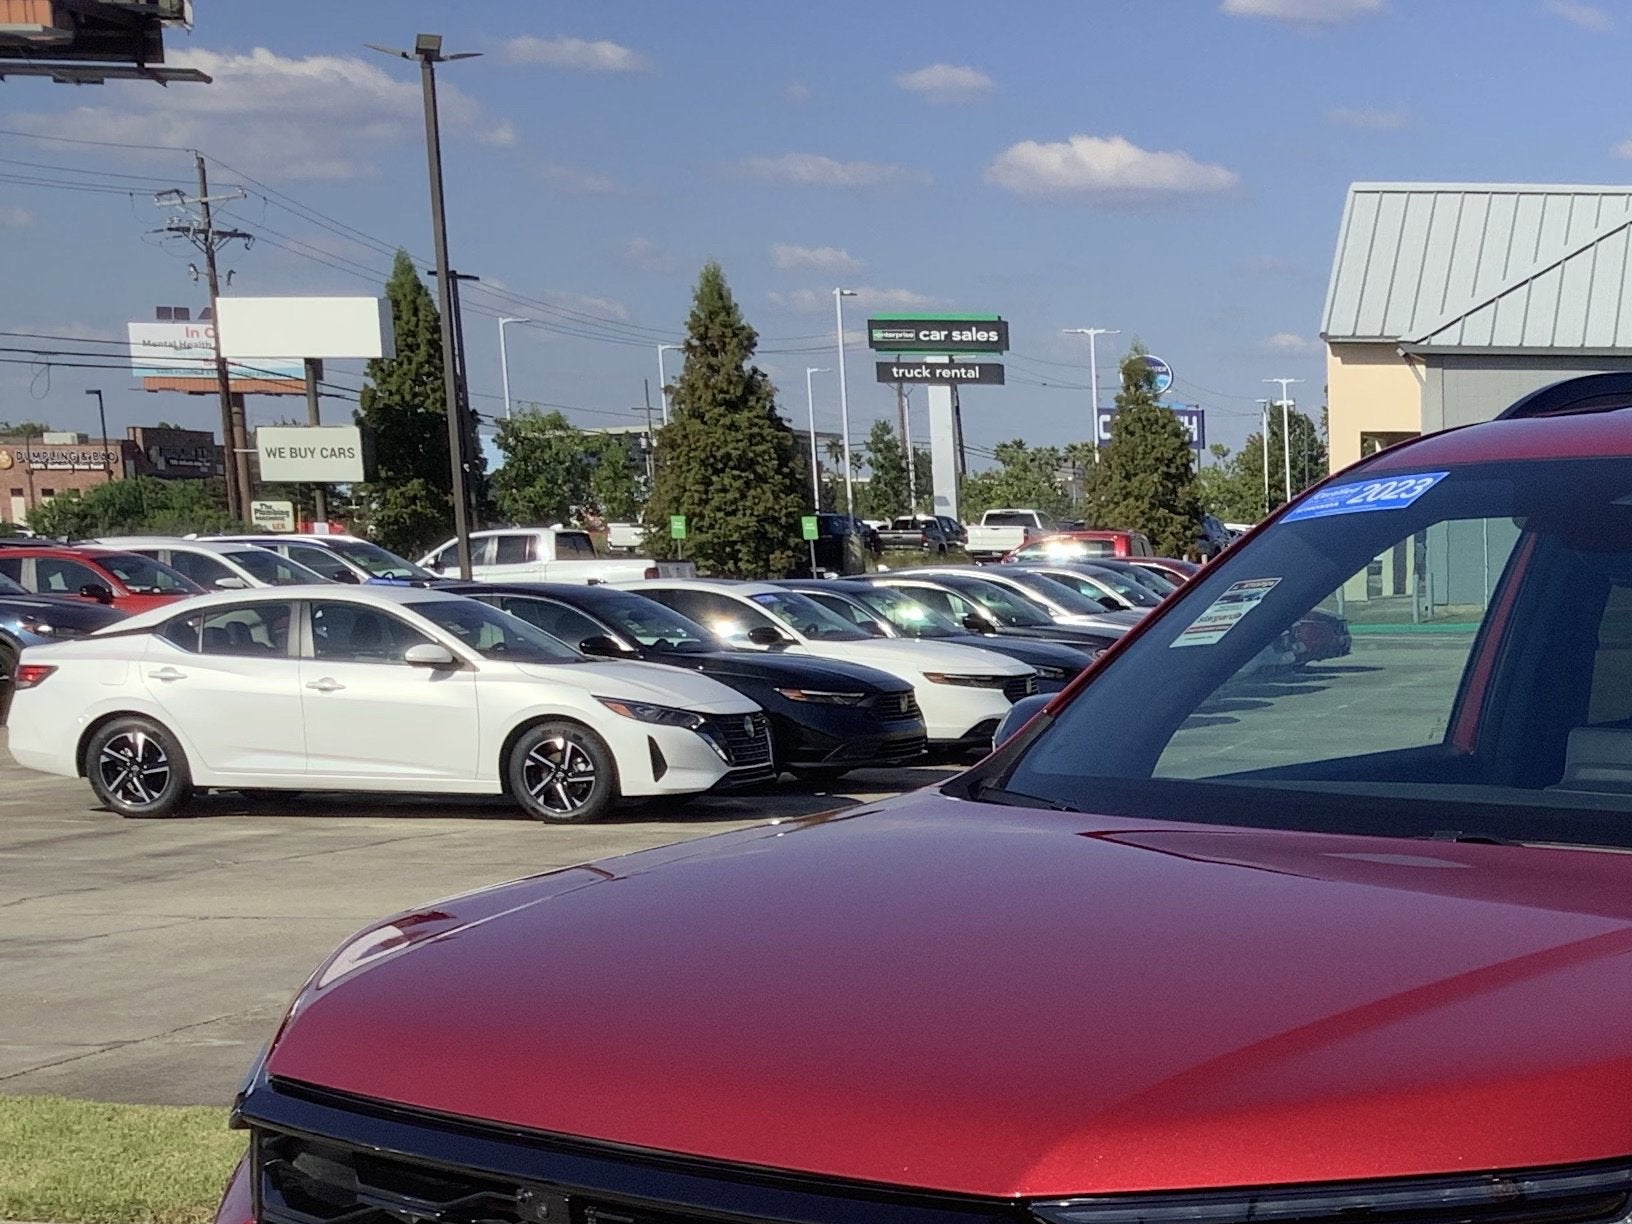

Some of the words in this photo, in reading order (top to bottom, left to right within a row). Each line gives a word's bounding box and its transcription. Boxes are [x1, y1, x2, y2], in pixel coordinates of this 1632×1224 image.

[919, 330, 948, 341] car
[952, 326, 999, 341] sales
[891, 365, 931, 378] truck
[936, 366, 980, 379] rental
[265, 447, 286, 459] WE
[289, 447, 316, 459] BUY
[320, 447, 355, 459] CARS
[1346, 477, 1434, 504] 2023
